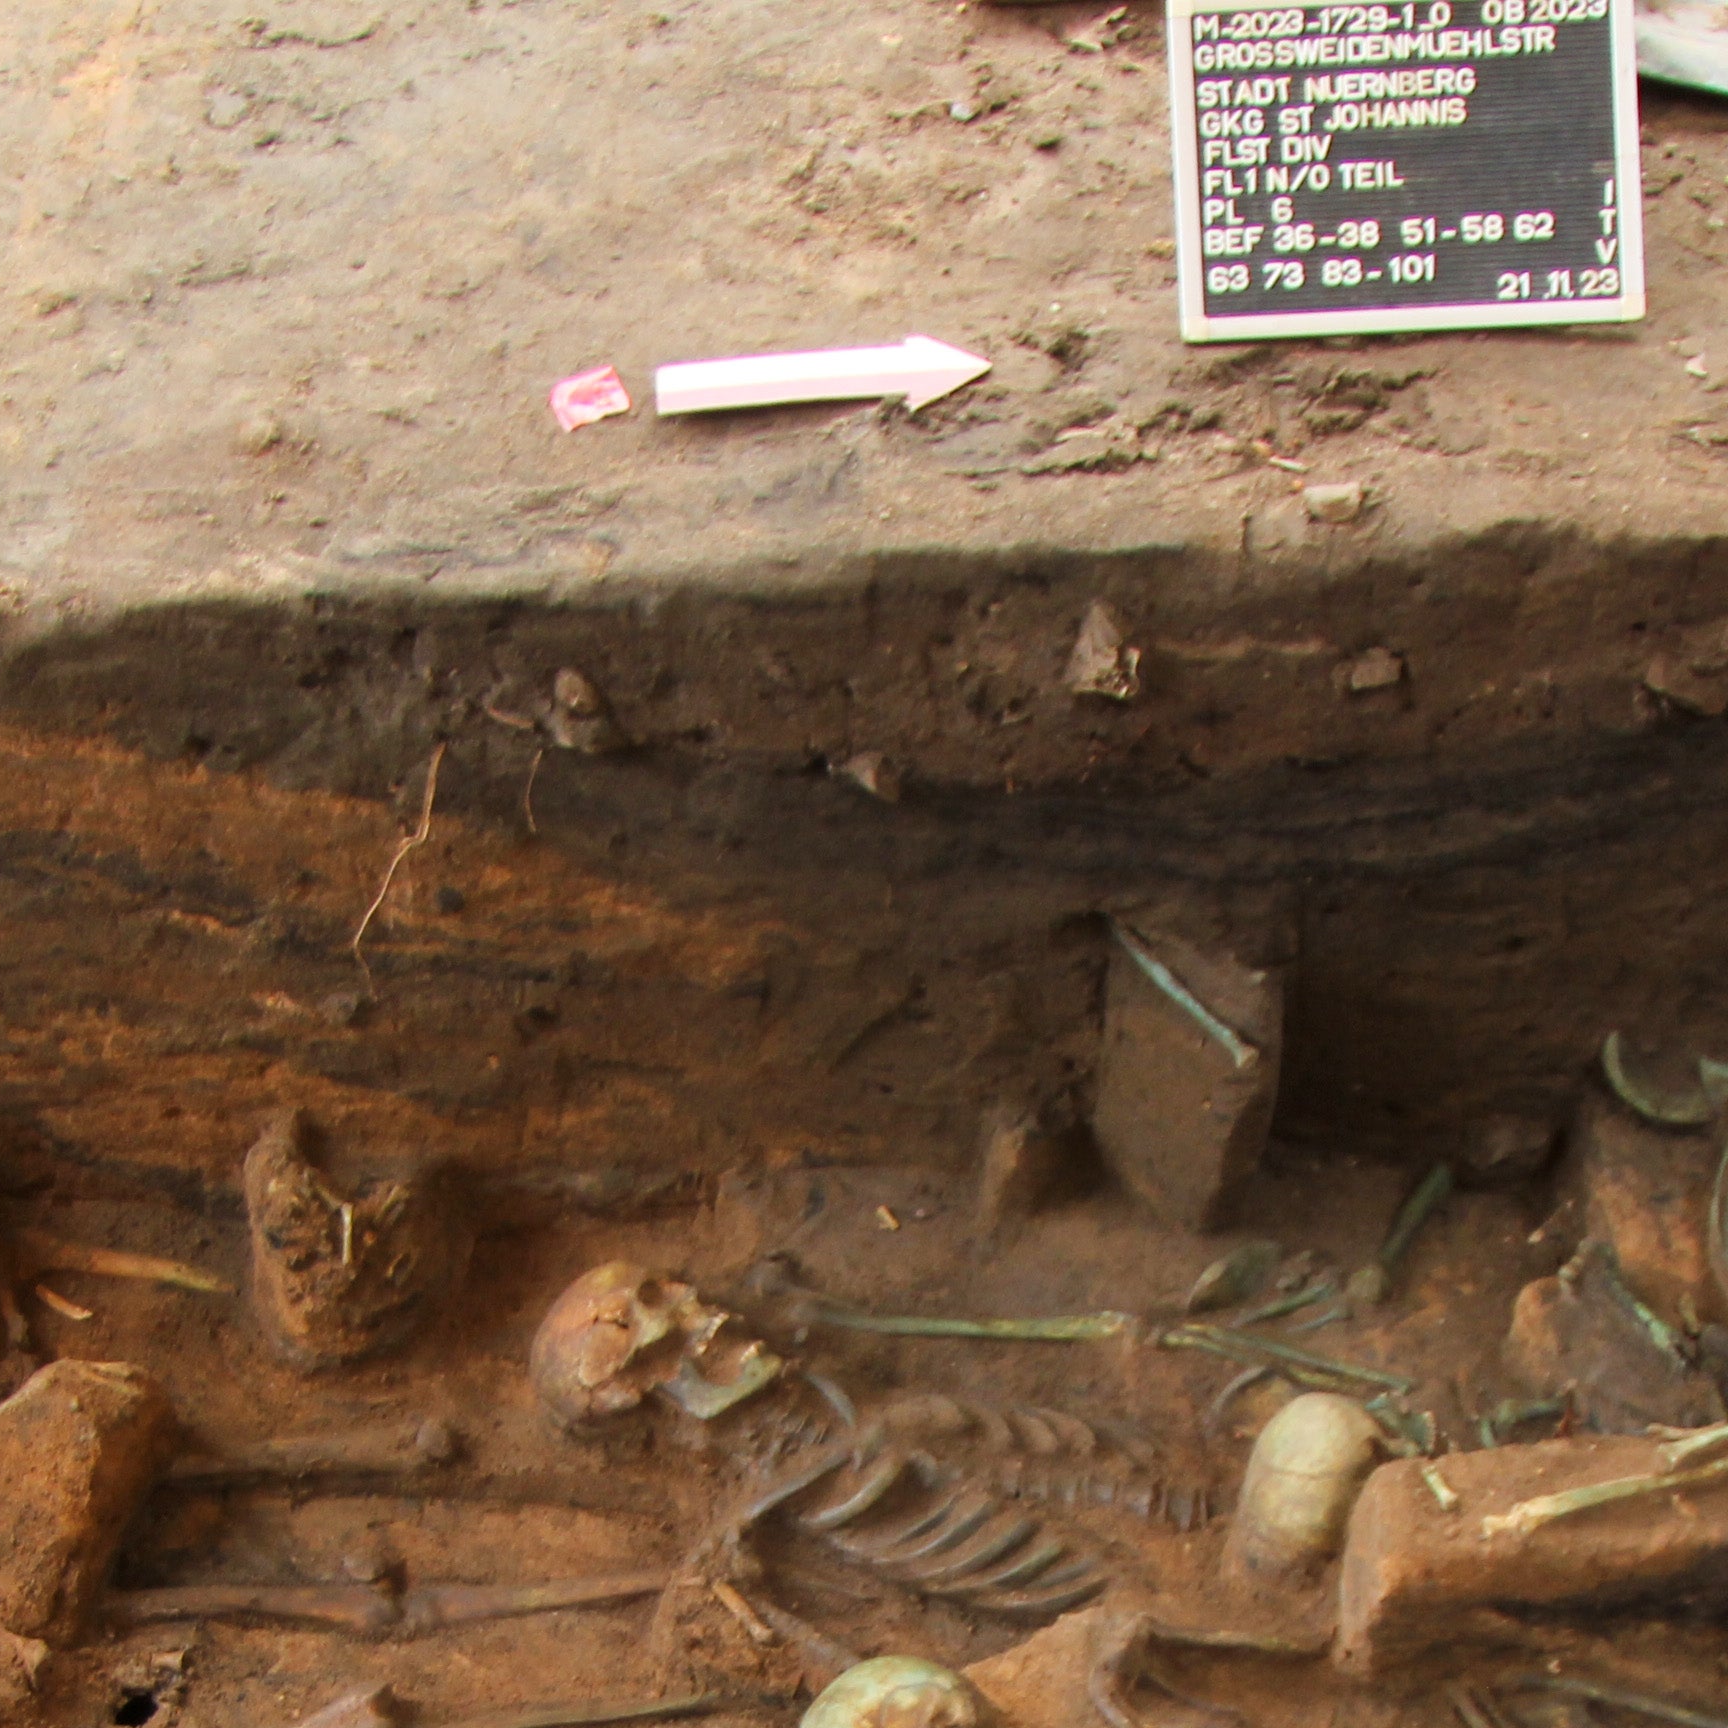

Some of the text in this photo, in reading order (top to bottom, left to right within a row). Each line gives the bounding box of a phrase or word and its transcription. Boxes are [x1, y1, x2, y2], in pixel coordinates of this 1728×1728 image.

[1530, 0, 1607, 23] 2023
[1194, 26, 1556, 71] GROSSWEIDENMUEHLSTR
[1197, 68, 1476, 108] STADT NUERNBERG
[1200, 98, 1467, 138] GKG ST JOHANNIS
[1203, 134, 1332, 167] FLST DIV
[1338, 160, 1405, 190] TEIL
[1203, 196, 1293, 226] PL 6
[1204, 211, 1556, 257] BEF 36-38 51-58 62
[1207, 264, 1250, 295] 63
[1262, 260, 1305, 291] 73
